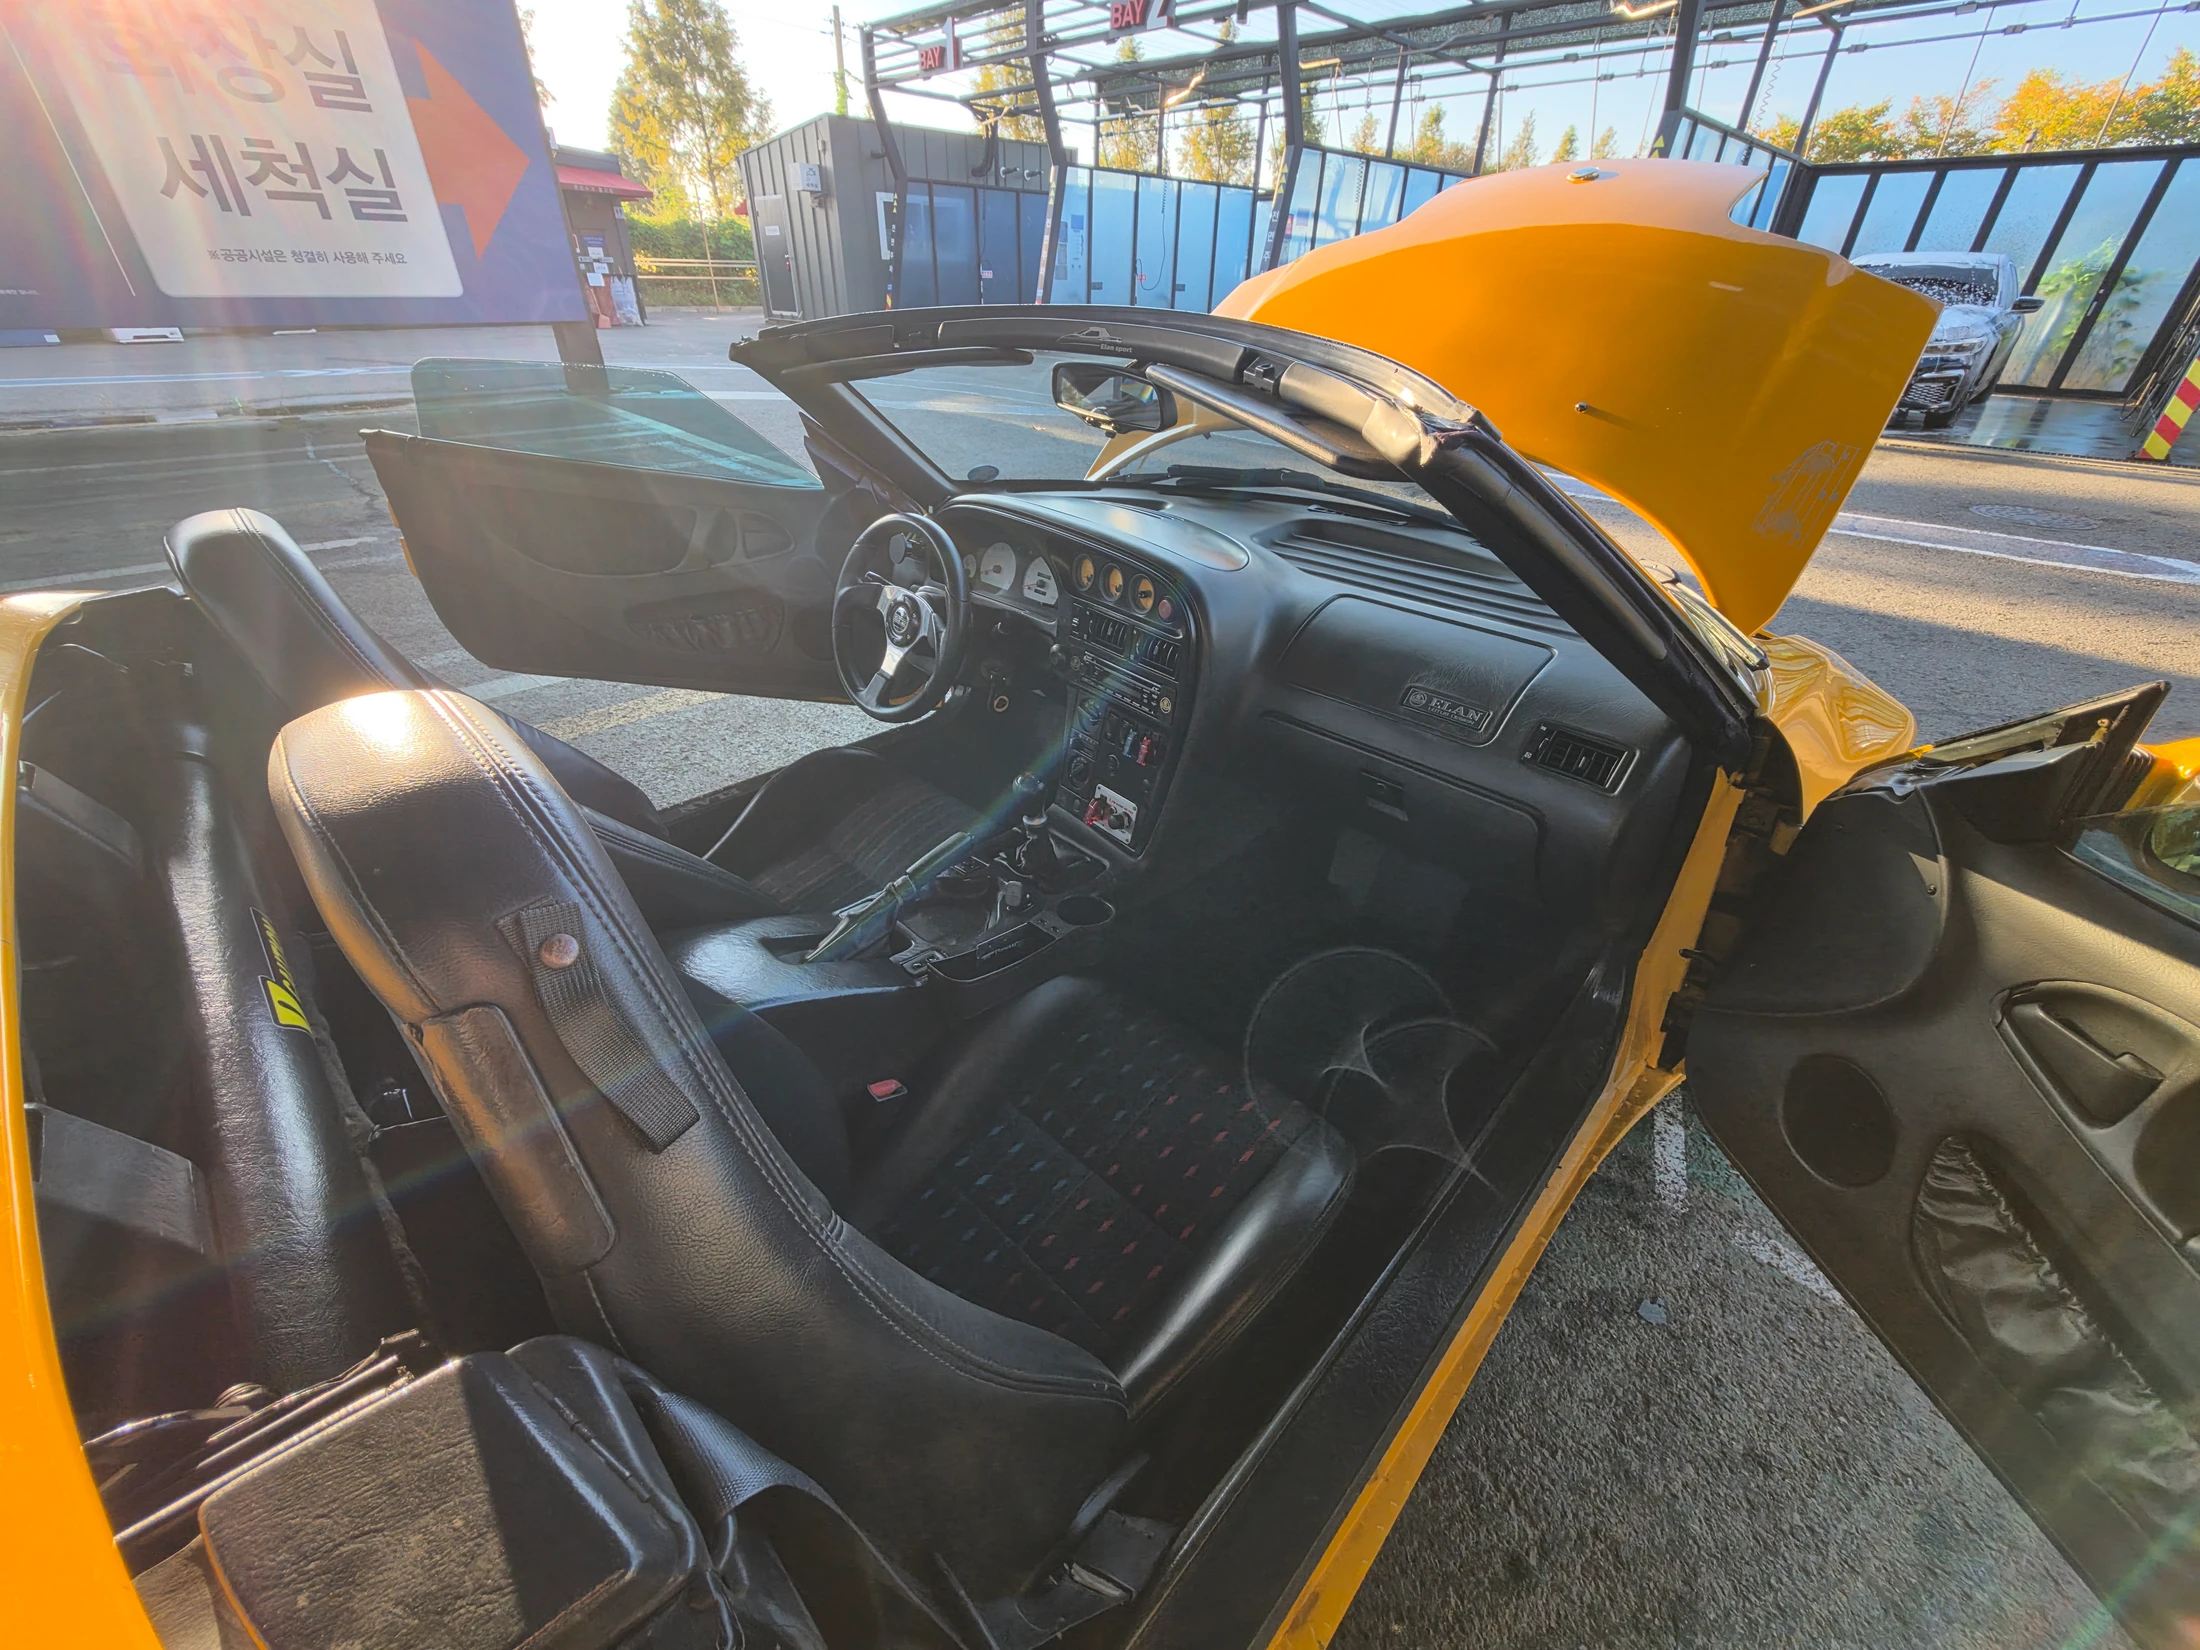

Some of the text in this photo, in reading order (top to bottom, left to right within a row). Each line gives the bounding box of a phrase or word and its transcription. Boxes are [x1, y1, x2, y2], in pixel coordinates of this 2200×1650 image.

[1111, 0, 1145, 28] BAY
[920, 16, 956, 70] BAY 1
[156, 134, 408, 222] 세척실
[291, 250, 329, 264] 청결히
[333, 251, 369, 265] 사용해
[372, 252, 407, 265] 주세요
[1100, 343, 1133, 353] Elan sport
[1429, 697, 1483, 721] ELAN
